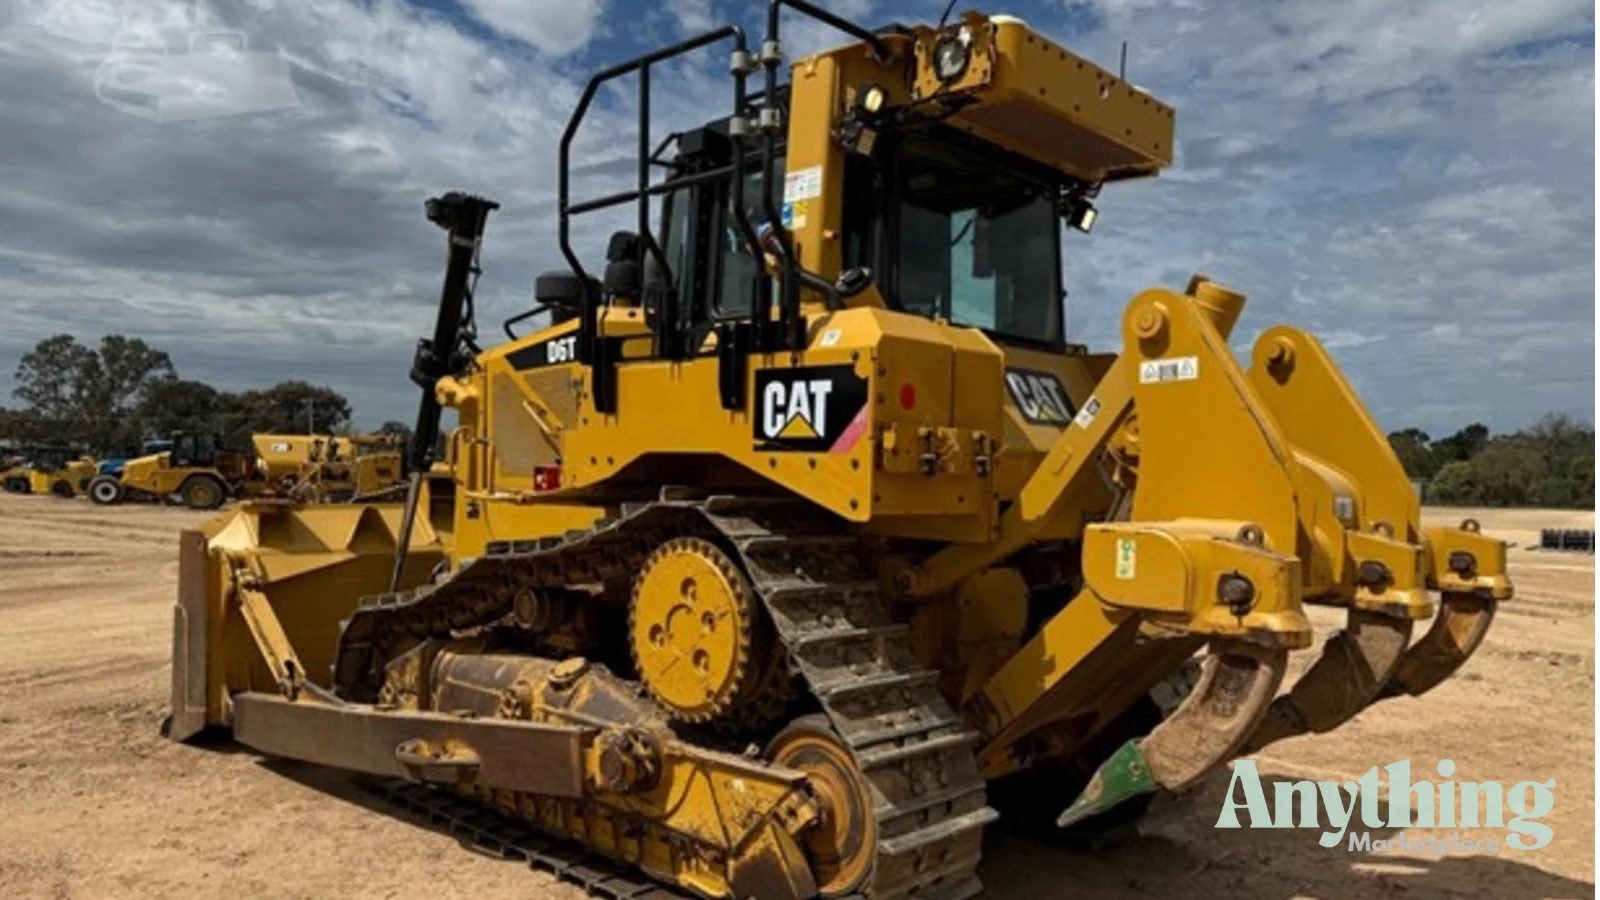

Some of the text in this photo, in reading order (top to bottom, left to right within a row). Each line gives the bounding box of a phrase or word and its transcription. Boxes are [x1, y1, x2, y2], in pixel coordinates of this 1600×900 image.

[547, 336, 577, 363] D6T
[763, 380, 832, 438] CAT
[1006, 372, 1072, 420] CAT
